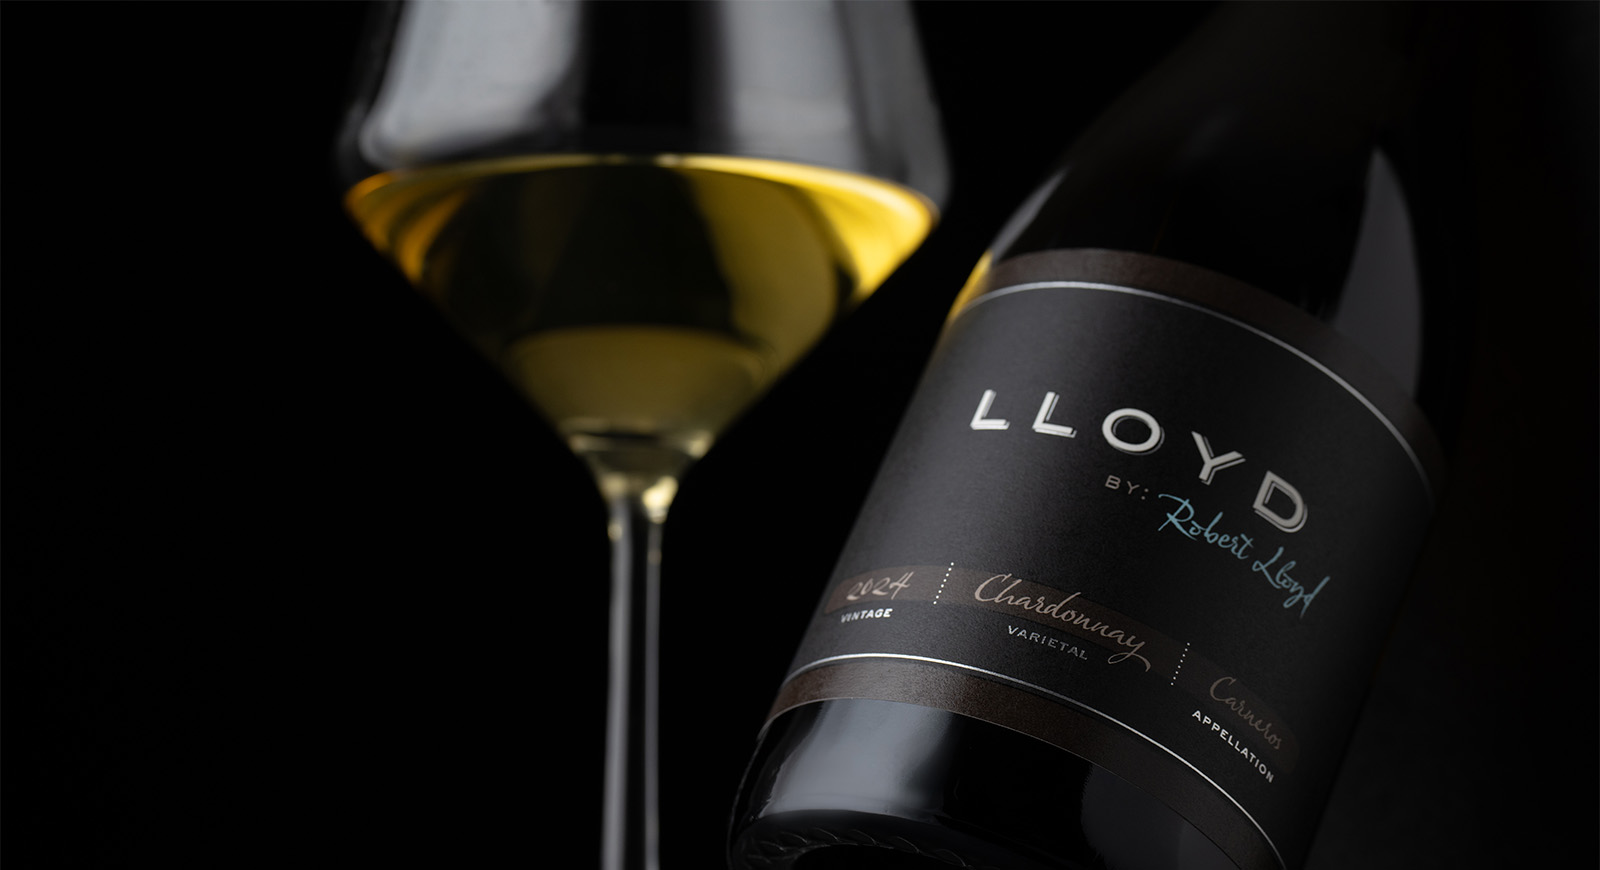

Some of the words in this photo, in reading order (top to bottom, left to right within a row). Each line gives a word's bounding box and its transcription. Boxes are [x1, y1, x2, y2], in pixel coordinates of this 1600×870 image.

[970, 389, 1308, 533] LLOYD
[1104, 475, 1149, 501] BY:
[1158, 493, 1254, 560] Robert
[1252, 546, 1330, 619] Lloyd
[840, 608, 893, 623] VINTAGE
[846, 571, 914, 601] 2024
[974, 573, 1151, 672] Chardonnay
[1008, 625, 1088, 661] VARIETAL
[1191, 710, 1275, 784] APPELLATION
[1209, 676, 1282, 750] Carneros
